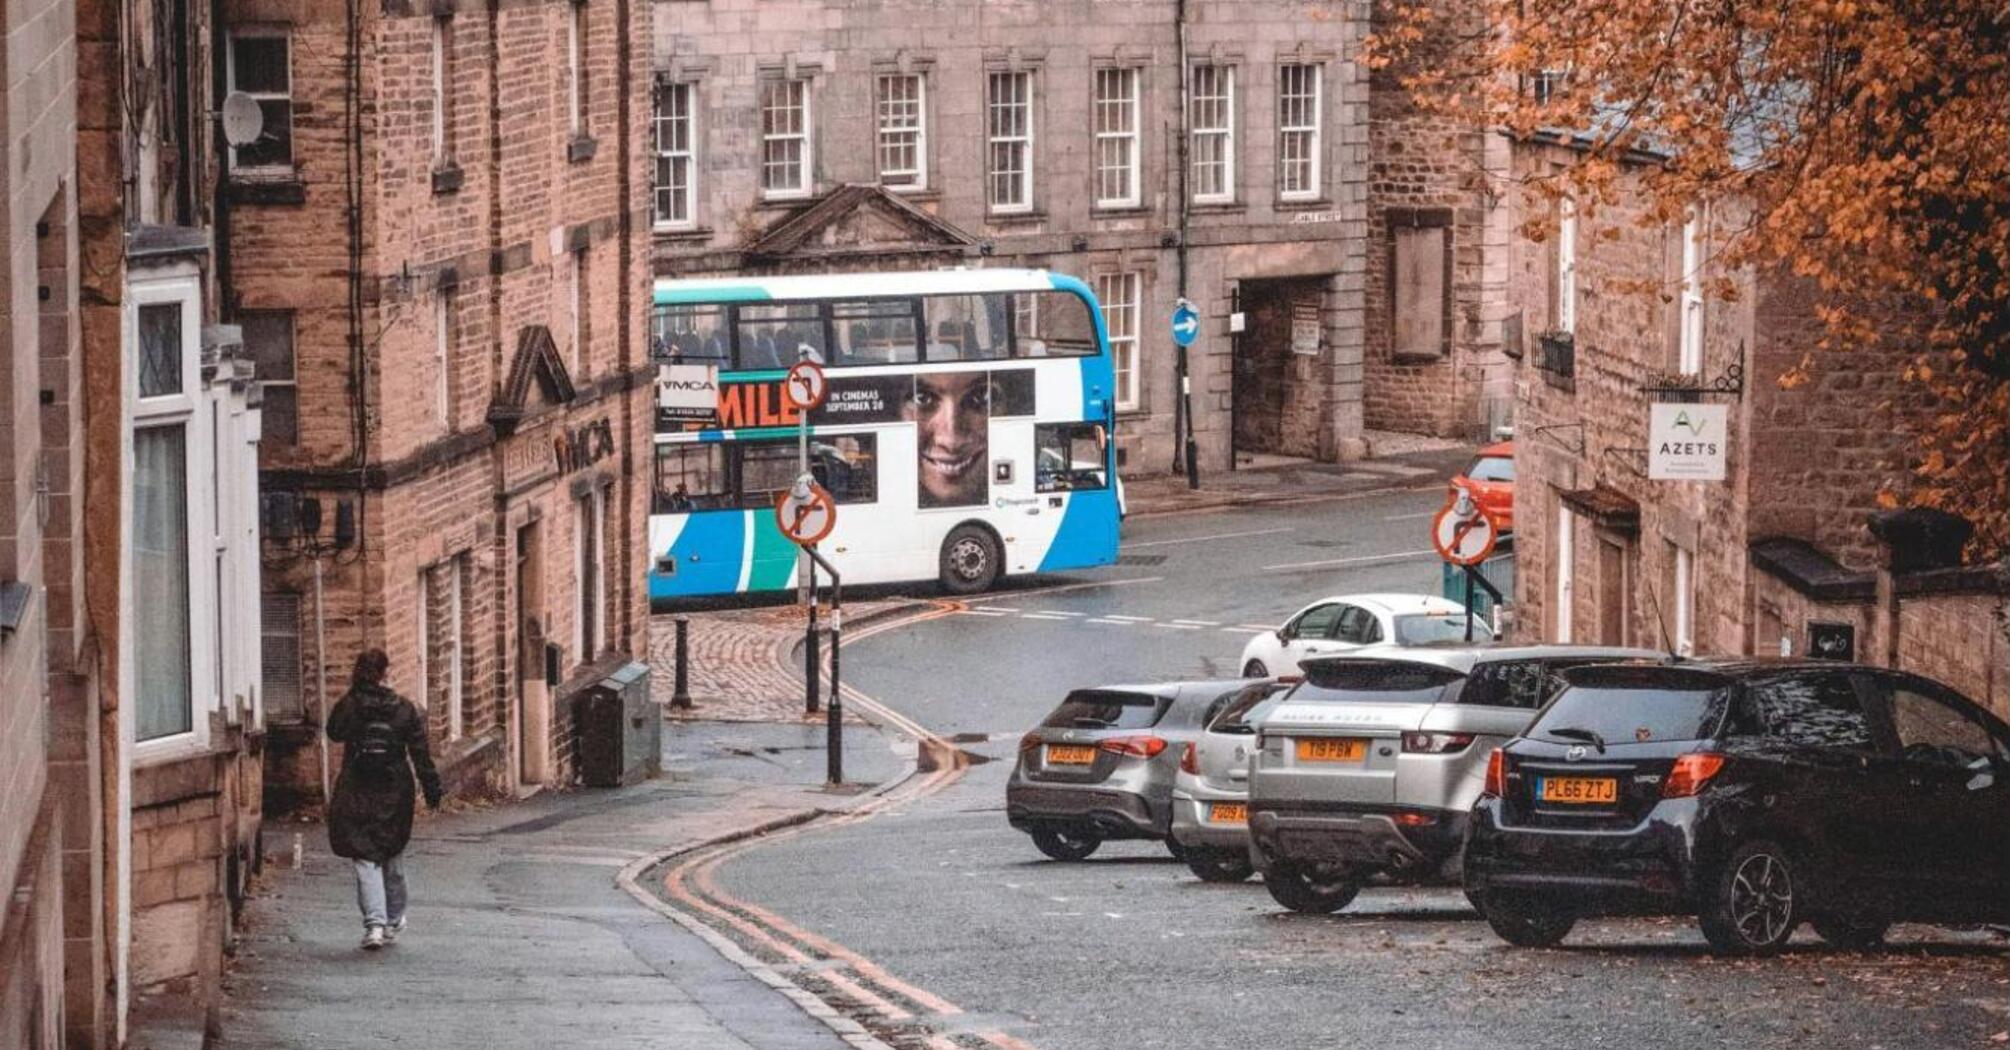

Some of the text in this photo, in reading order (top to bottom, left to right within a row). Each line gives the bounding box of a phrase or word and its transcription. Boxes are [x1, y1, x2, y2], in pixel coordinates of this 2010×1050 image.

[830, 390, 879, 401] IN CINEMAS
[682, 381, 800, 430] MILE
[825, 401, 870, 412] SEPTEMBER
[1660, 442, 1717, 455] AZETS
[1546, 780, 1614, 799] PL66 ZTJ
